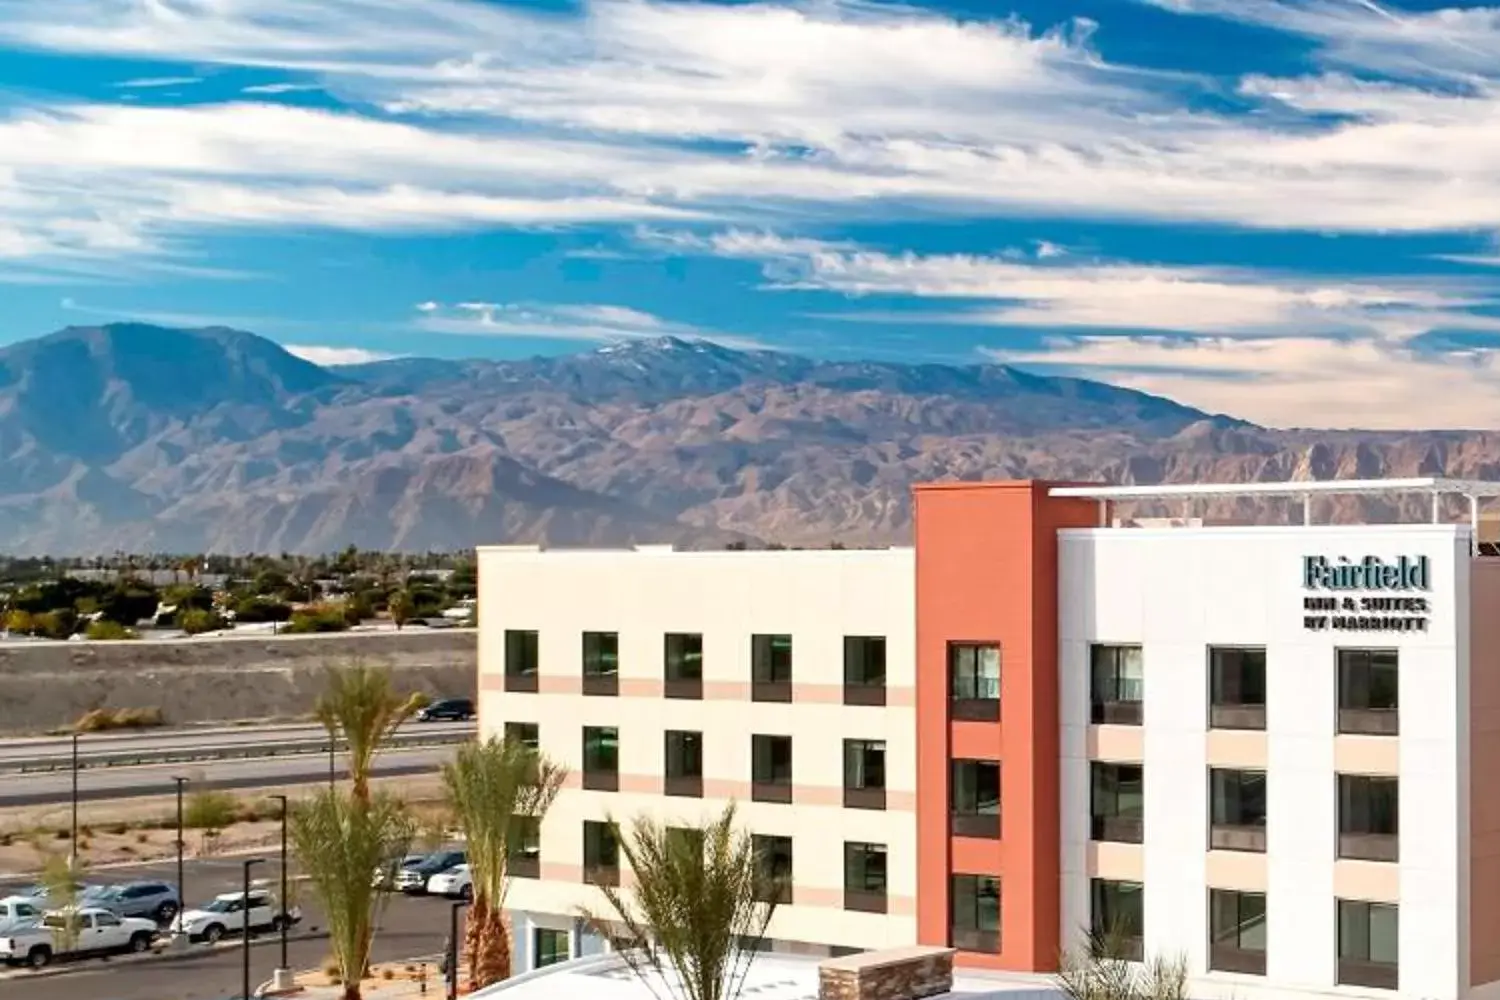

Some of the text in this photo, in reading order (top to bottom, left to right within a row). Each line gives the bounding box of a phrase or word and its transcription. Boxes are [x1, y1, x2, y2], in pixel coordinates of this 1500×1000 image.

[1303, 555, 1430, 591] Fairfield
[1304, 597, 1427, 612] INN & SUITES
[1304, 616, 1428, 631] BY MARRIOTT
